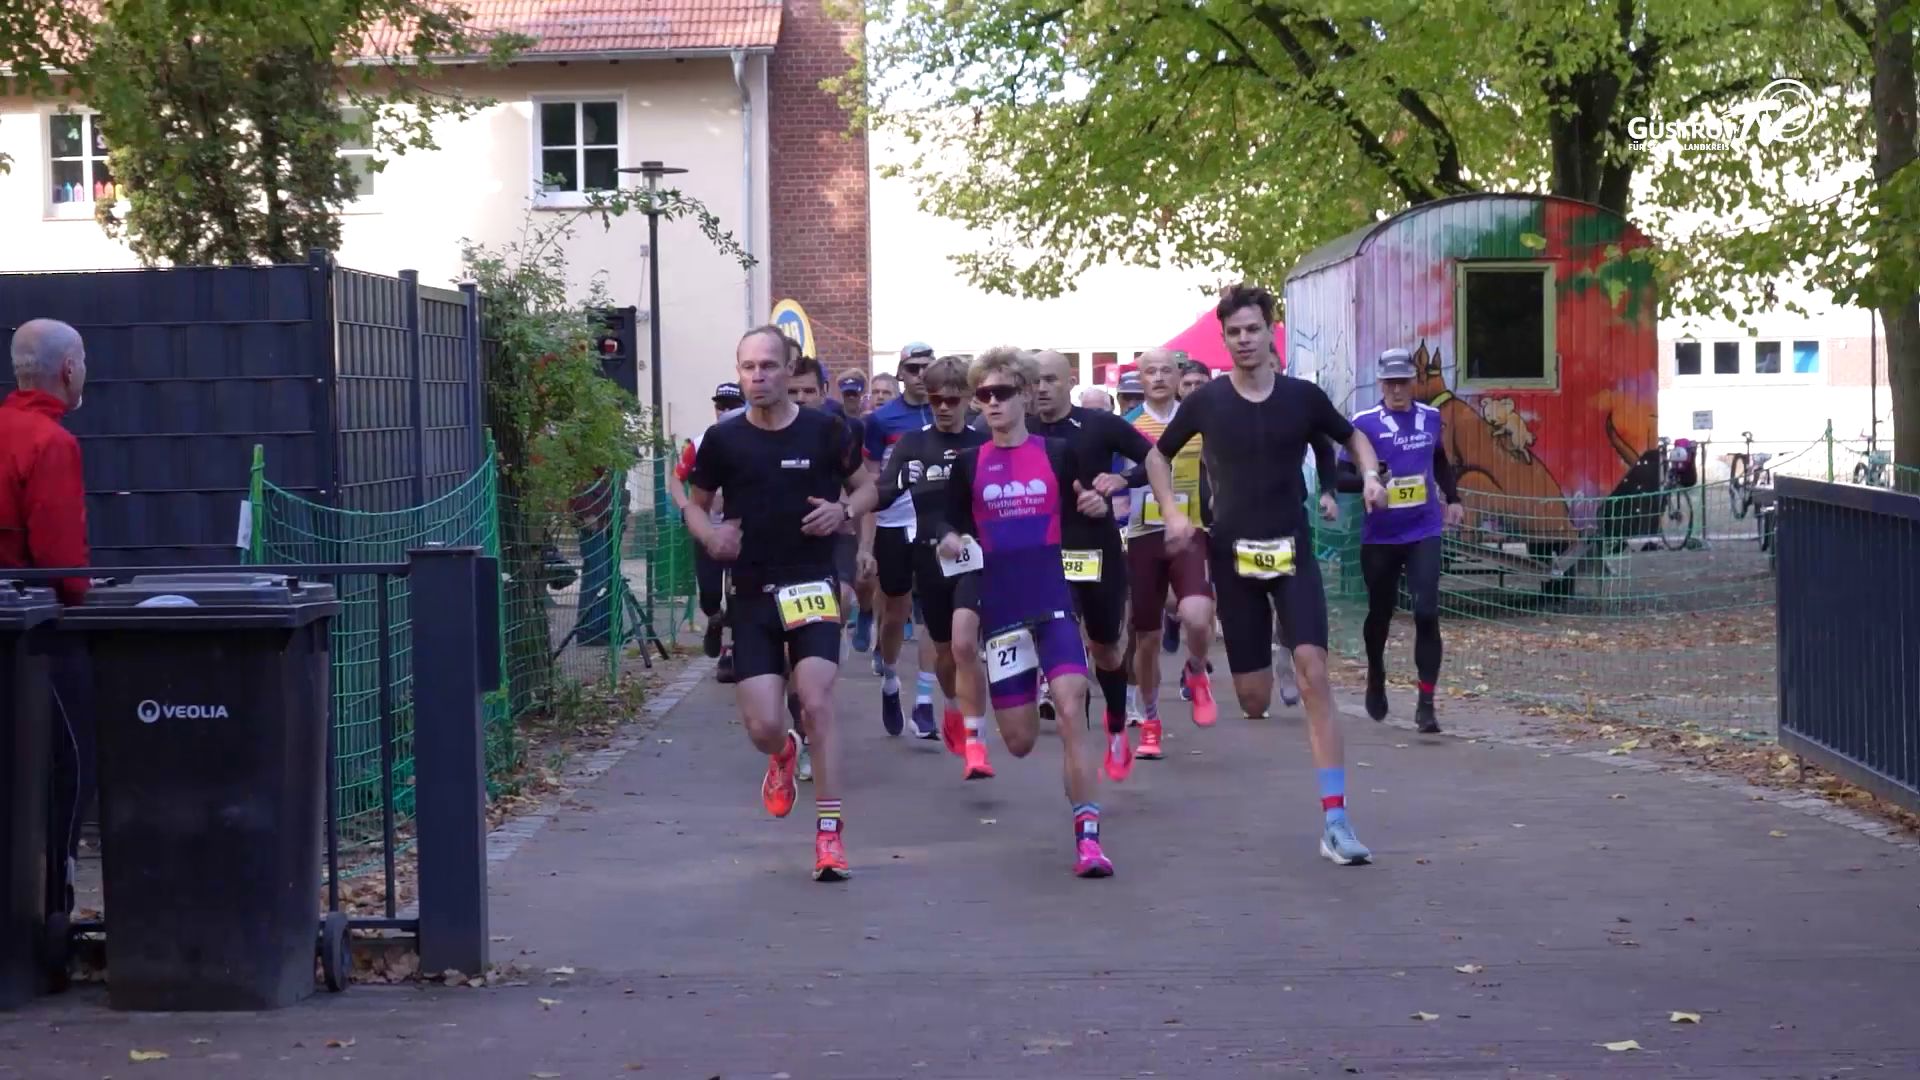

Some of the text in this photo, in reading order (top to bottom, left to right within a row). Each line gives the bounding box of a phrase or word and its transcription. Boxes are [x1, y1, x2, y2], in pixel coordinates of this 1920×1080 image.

[1399, 487, 1415, 500] 57
[987, 496, 1045, 510] Triathlon Team
[793, 595, 826, 613] 119
[998, 646, 1017, 666] 27
[162, 704, 229, 719] VEOLIA
